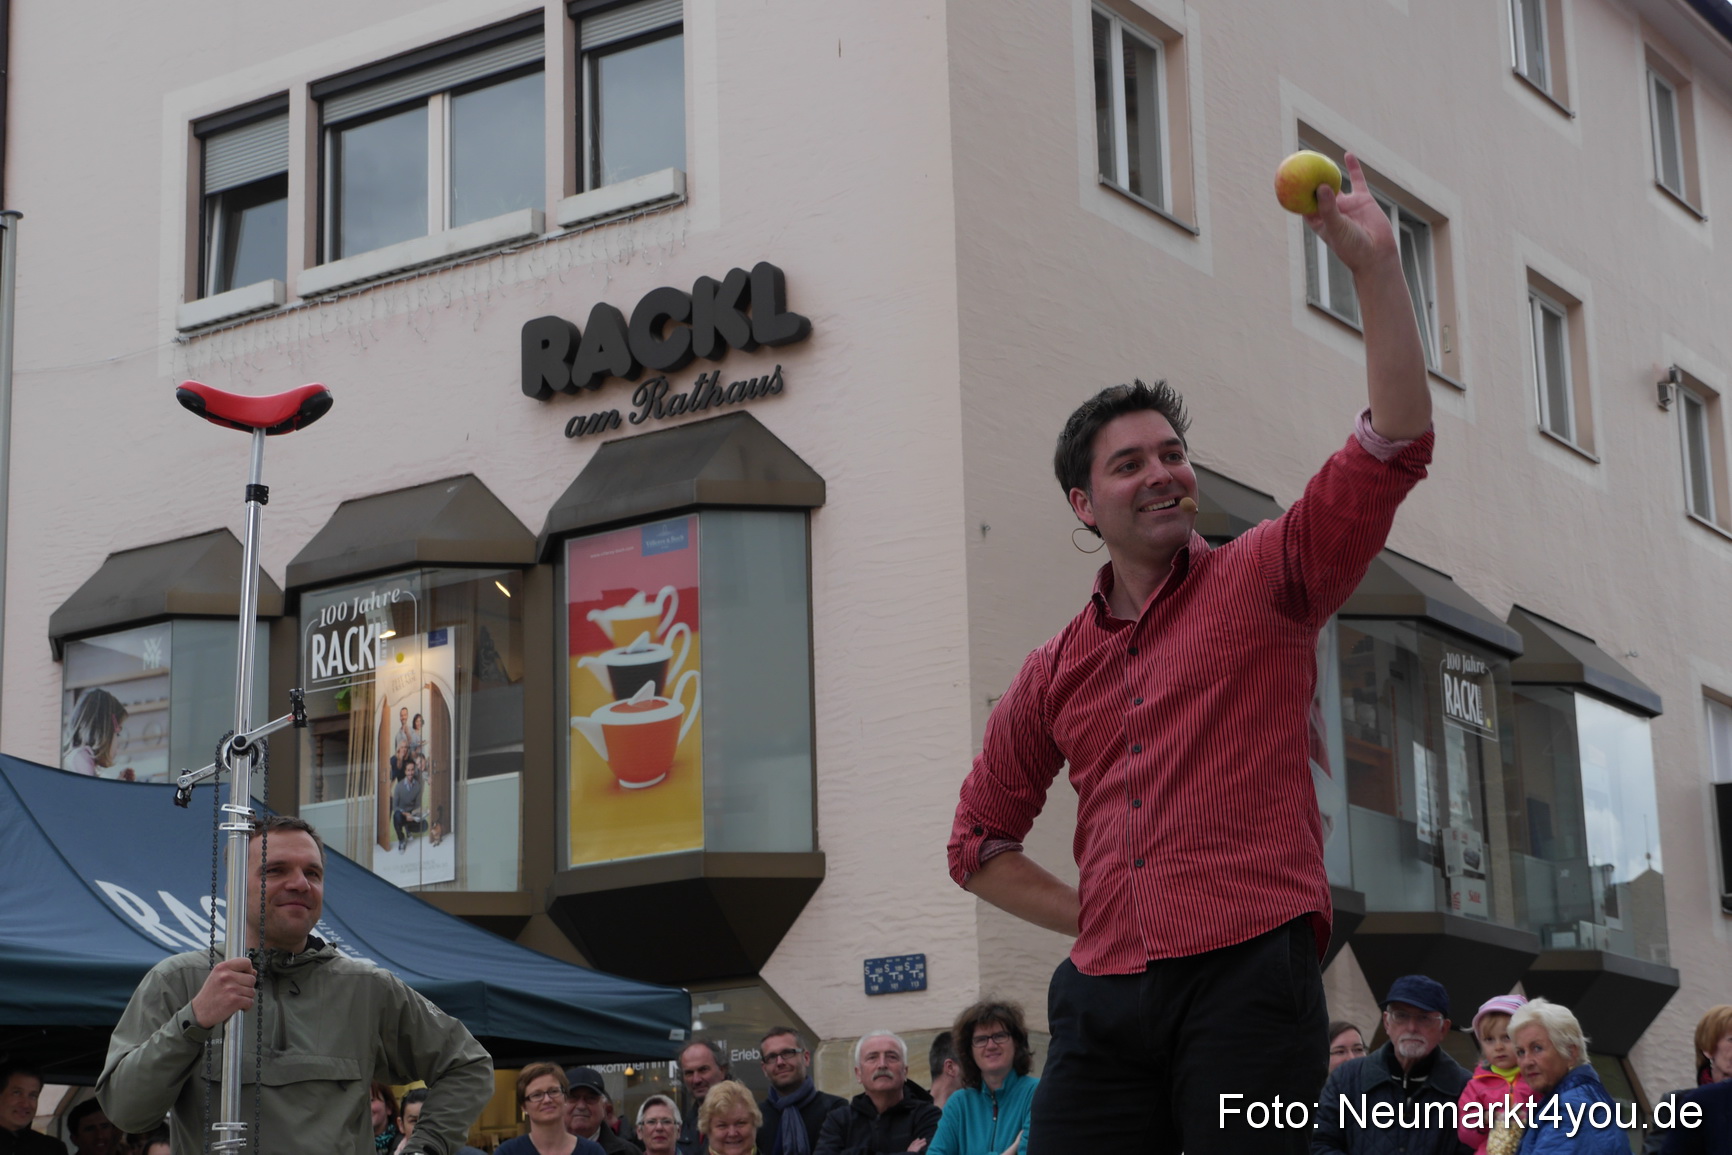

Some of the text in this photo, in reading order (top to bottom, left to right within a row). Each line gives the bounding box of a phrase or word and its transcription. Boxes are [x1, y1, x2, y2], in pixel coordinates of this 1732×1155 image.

[521, 261, 812, 402] RACKL
[564, 364, 785, 438] am Rathaus
[319, 587, 401, 628] 100 Jahre
[311, 621, 388, 680] RACKL
[1446, 652, 1486, 674] 100 Jahre
[1443, 673, 1484, 726] RACKL
[731, 1047, 762, 1062] Erleb
